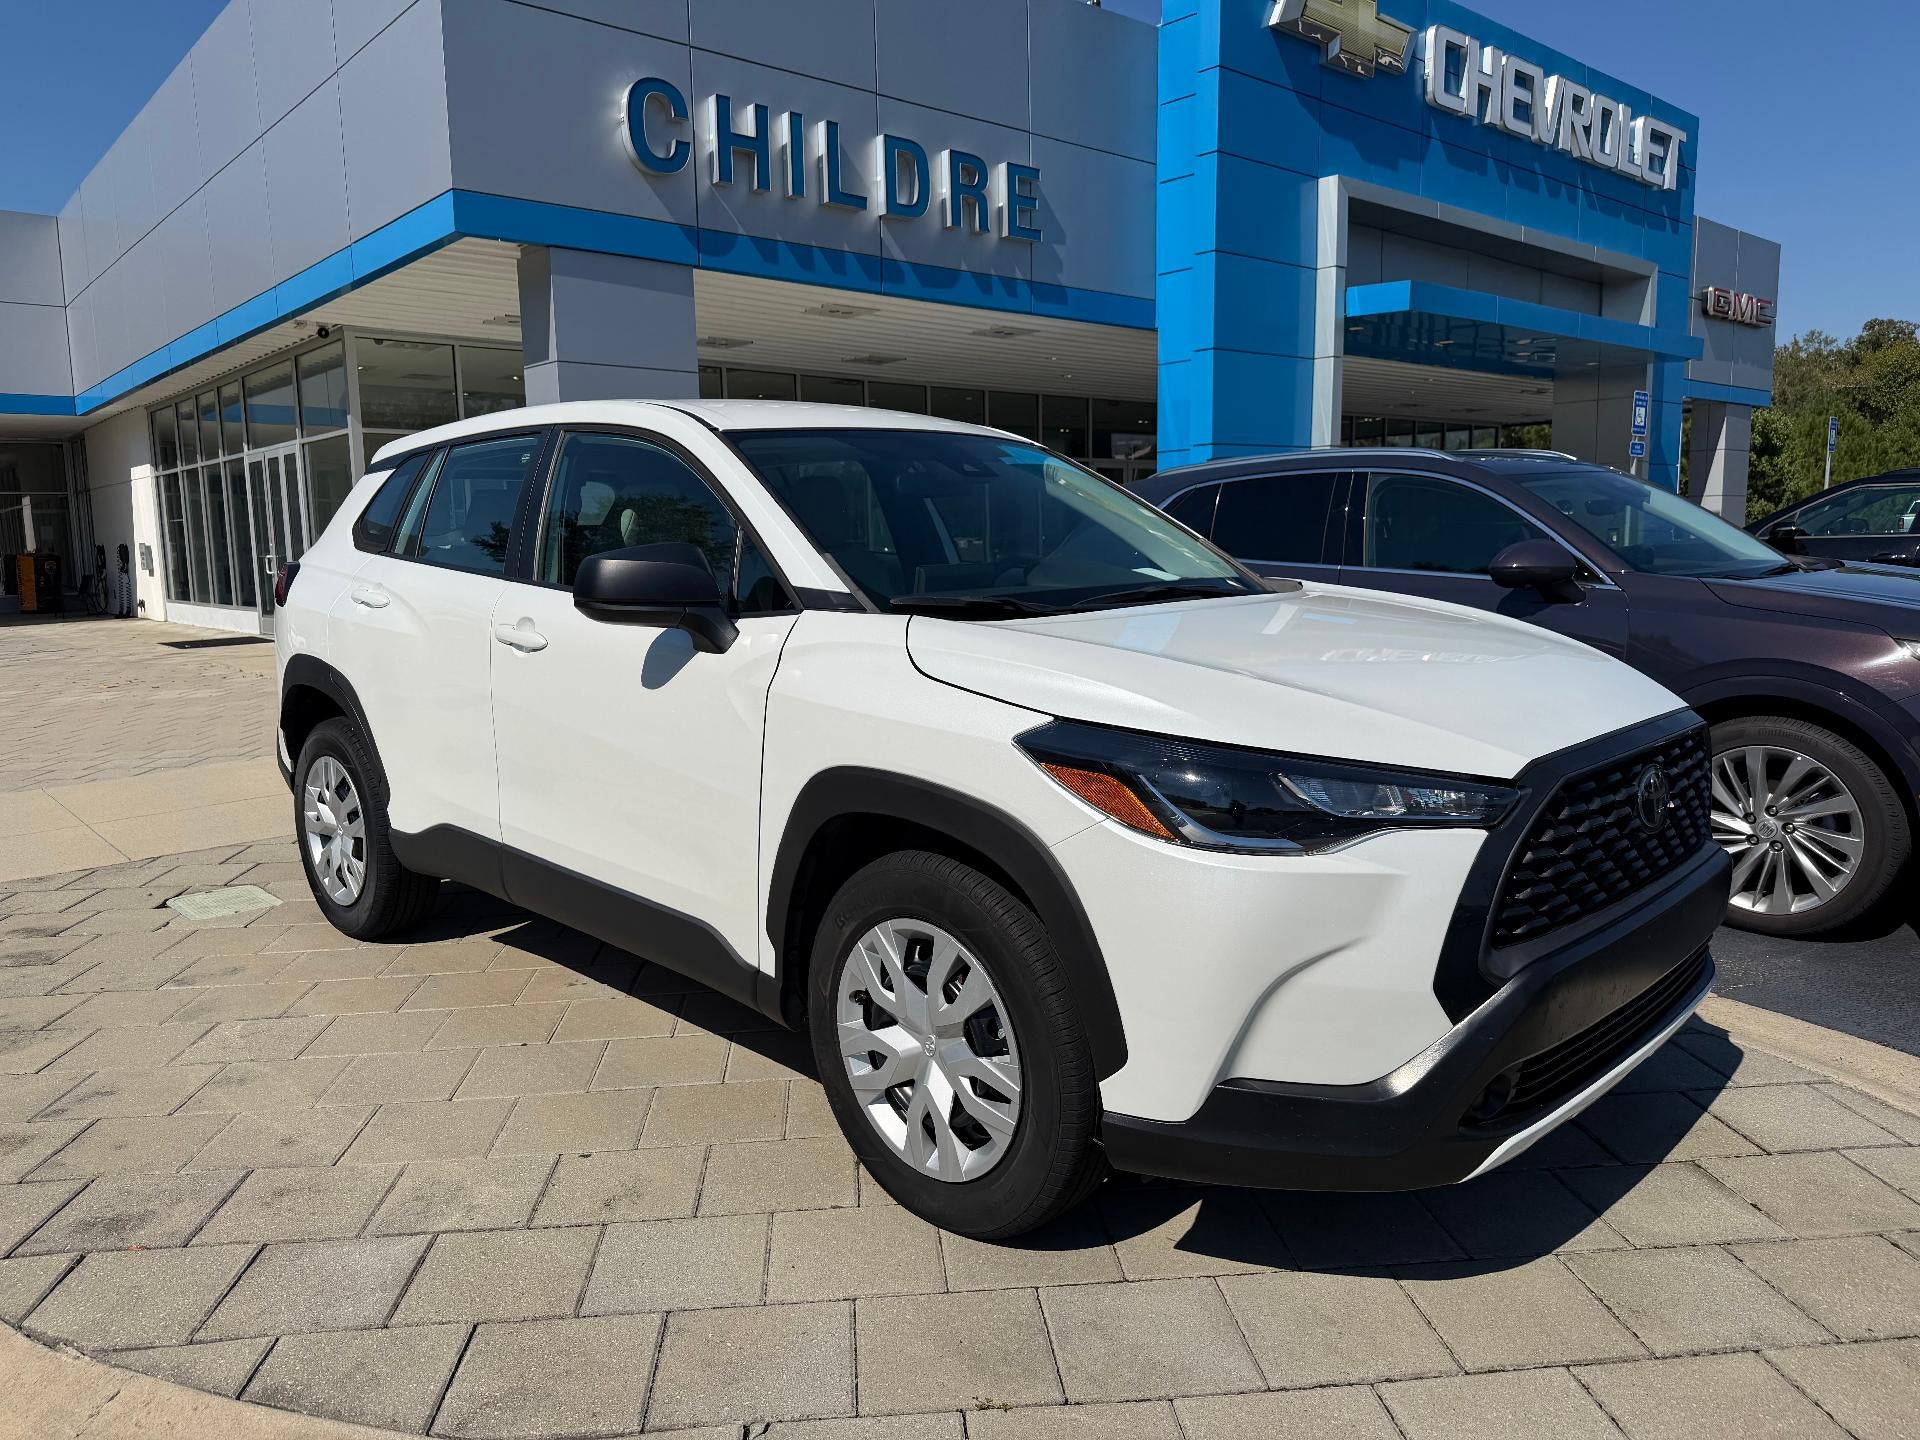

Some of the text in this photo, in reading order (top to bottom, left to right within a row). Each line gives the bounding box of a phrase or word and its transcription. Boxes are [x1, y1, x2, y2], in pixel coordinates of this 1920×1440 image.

[622, 77, 1042, 242] CHILDRE
[1426, 24, 1686, 190] CHEVROLET
[1707, 286, 1774, 326] GMC
